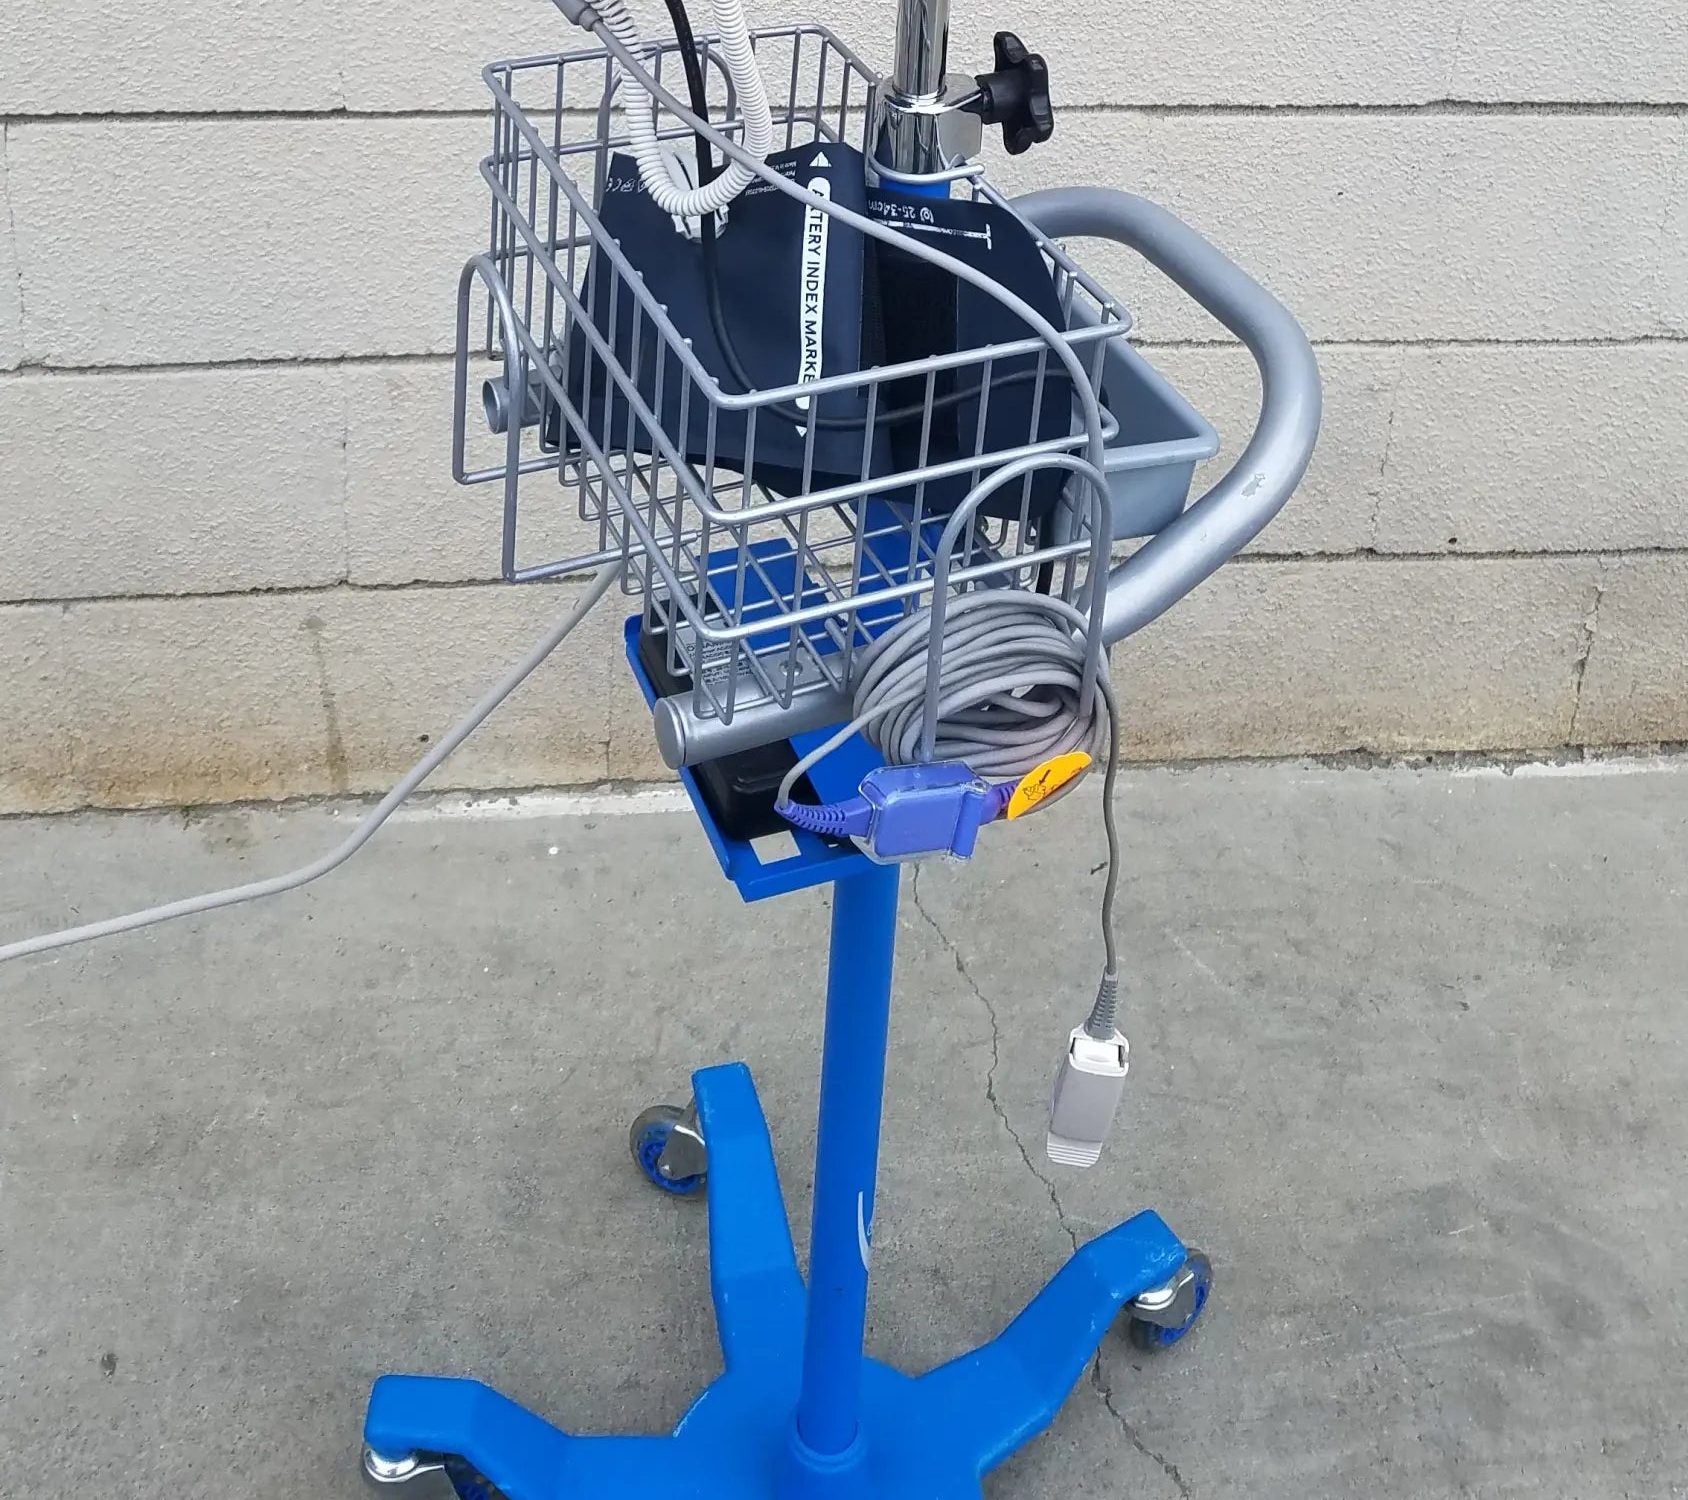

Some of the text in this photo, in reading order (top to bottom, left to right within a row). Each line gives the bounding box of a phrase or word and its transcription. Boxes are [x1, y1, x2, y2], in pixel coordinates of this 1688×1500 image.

[803, 188, 824, 384] ATERY INDEX MARKE
